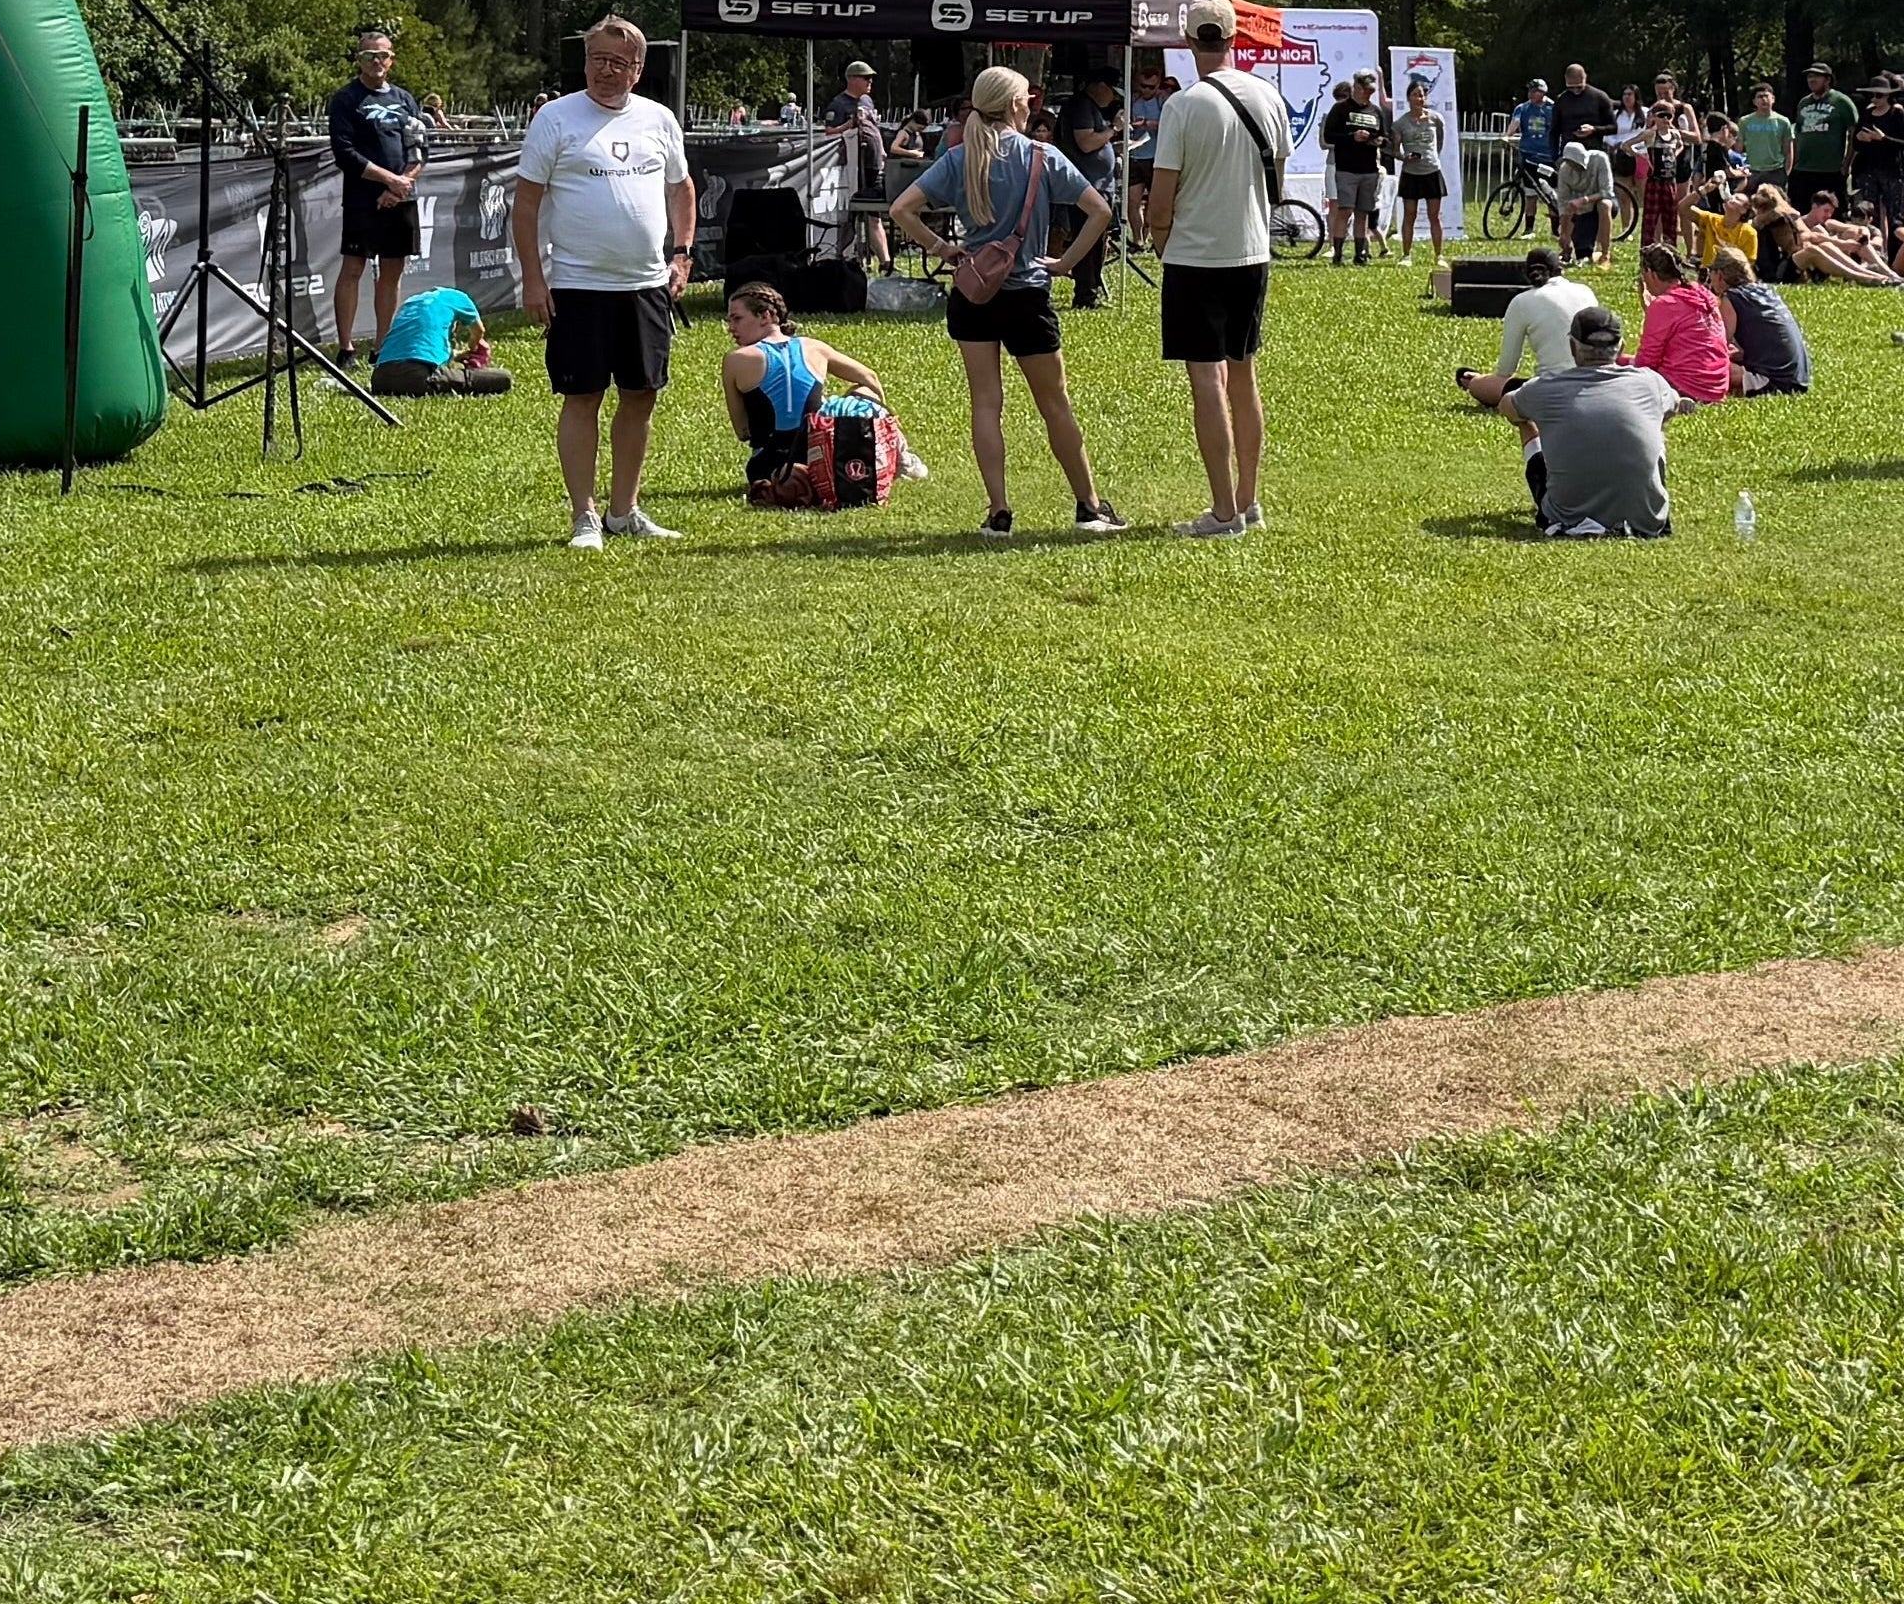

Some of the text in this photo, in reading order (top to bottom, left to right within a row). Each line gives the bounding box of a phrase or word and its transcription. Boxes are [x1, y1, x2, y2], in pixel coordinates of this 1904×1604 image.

[771, 0, 876, 17] SETUP
[985, 9, 1094, 25] SETUP
[1237, 49, 1312, 61] NC JUNIOR
